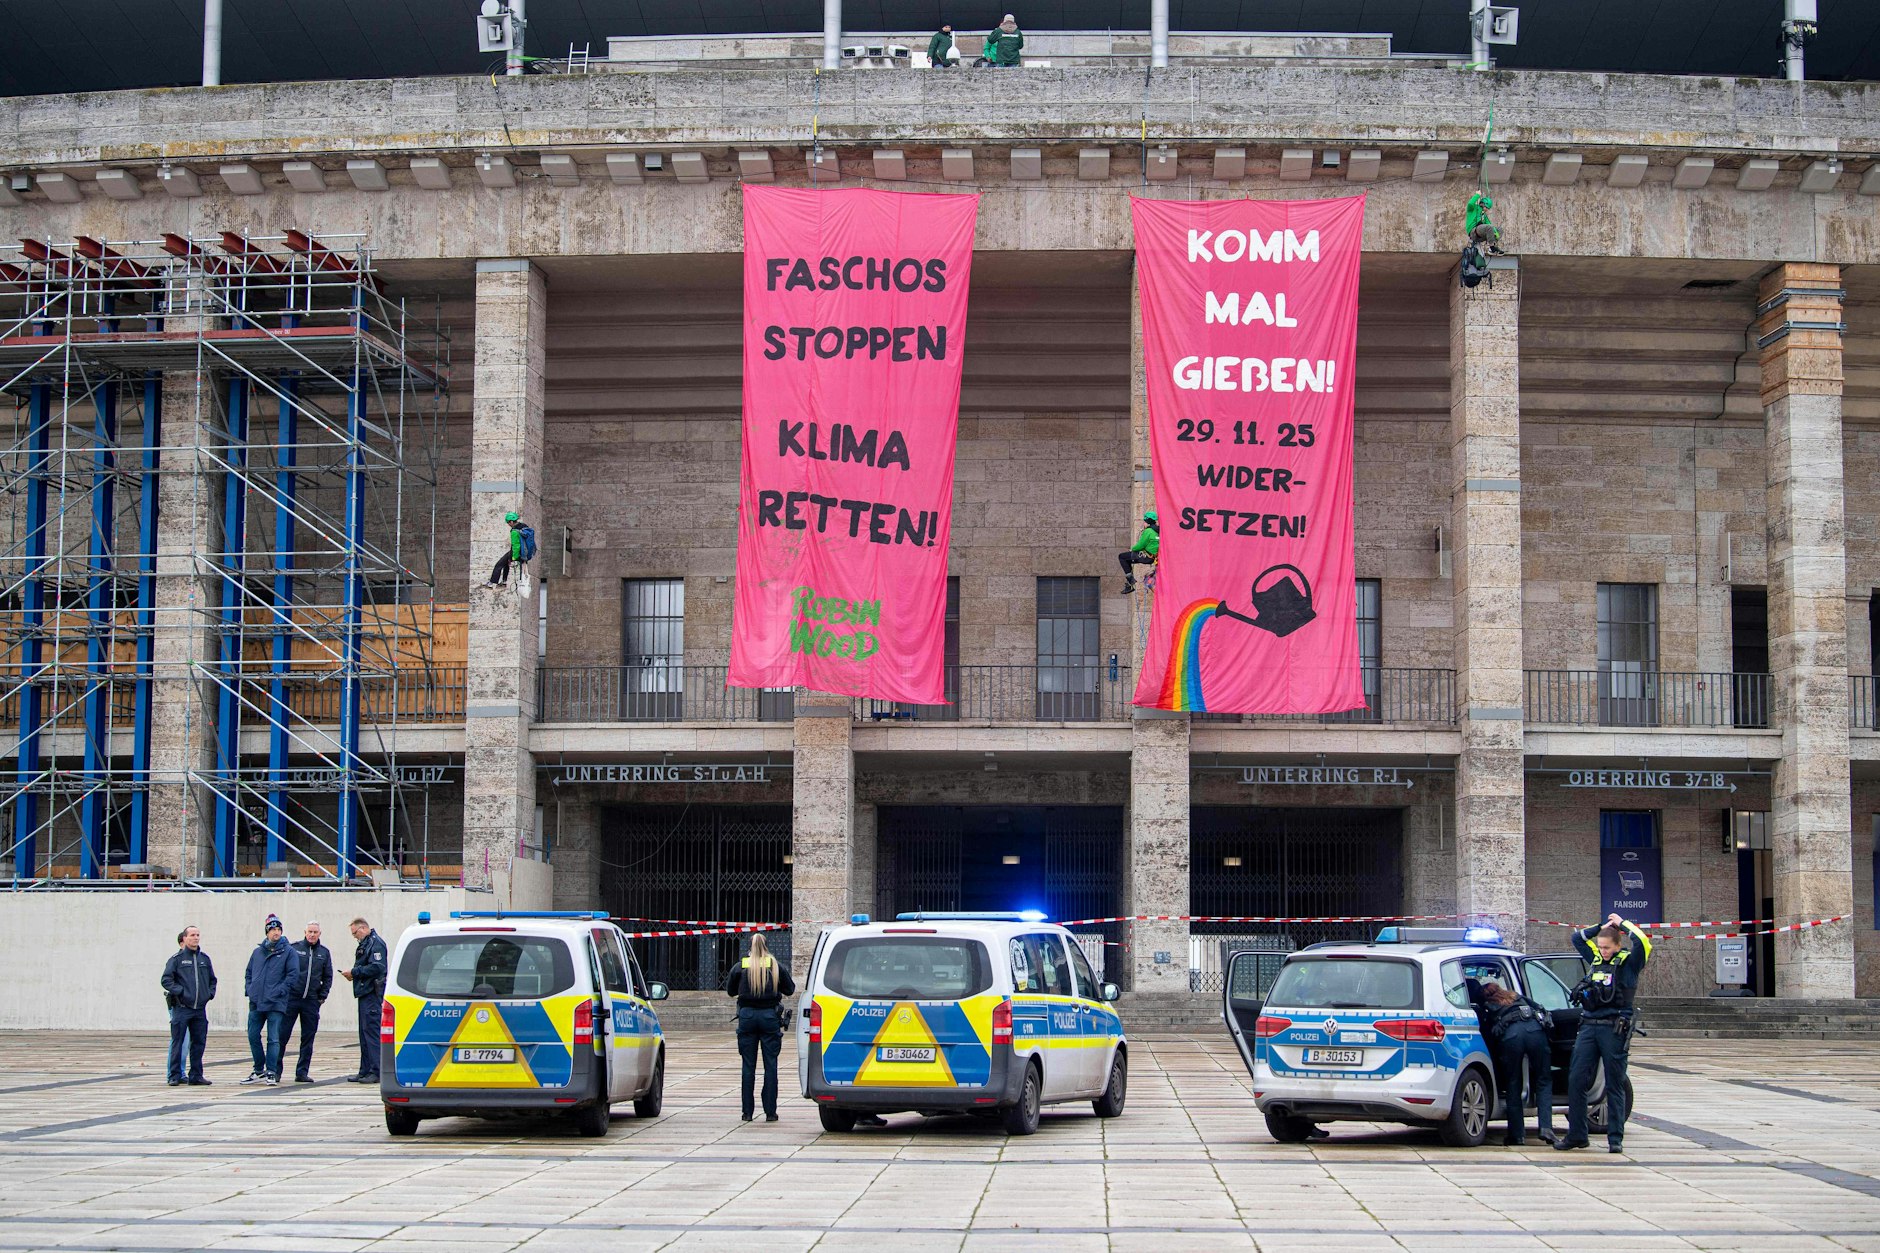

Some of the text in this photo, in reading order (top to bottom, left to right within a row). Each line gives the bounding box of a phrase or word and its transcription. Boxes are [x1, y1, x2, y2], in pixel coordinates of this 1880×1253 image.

[1188, 229, 1320, 264] KOMM
[766, 256, 947, 292] FASCHOS
[1205, 291, 1298, 327] MAL
[763, 325, 947, 362] STOPPEN
[1177, 419, 1315, 447] 29. 11. 25
[779, 420, 910, 471] KLIMA
[1197, 464, 1306, 493] WIDER-
[758, 490, 938, 547] RETTEN!
[1179, 507, 1306, 538] SETZEN!
[790, 586, 881, 627] ROBIN
[789, 619, 880, 661] WOOD
[565, 767, 680, 781] UNTERRING
[1243, 768, 1398, 783] UNTERRING R-J
[1569, 771, 1725, 787] OBERRING 37-18
[1613, 900, 1648, 909] FANSHOP
[424, 1009, 462, 1018] POLIZEI
[851, 1007, 886, 1018] POLIZEI
[1053, 1012, 1077, 1029] POLIZEI
[1290, 1032, 1320, 1041] POLIZEI
[463, 1050, 504, 1060] B 7794
[886, 1049, 930, 1059] B 30462
[1313, 1050, 1357, 1062] B 30153
